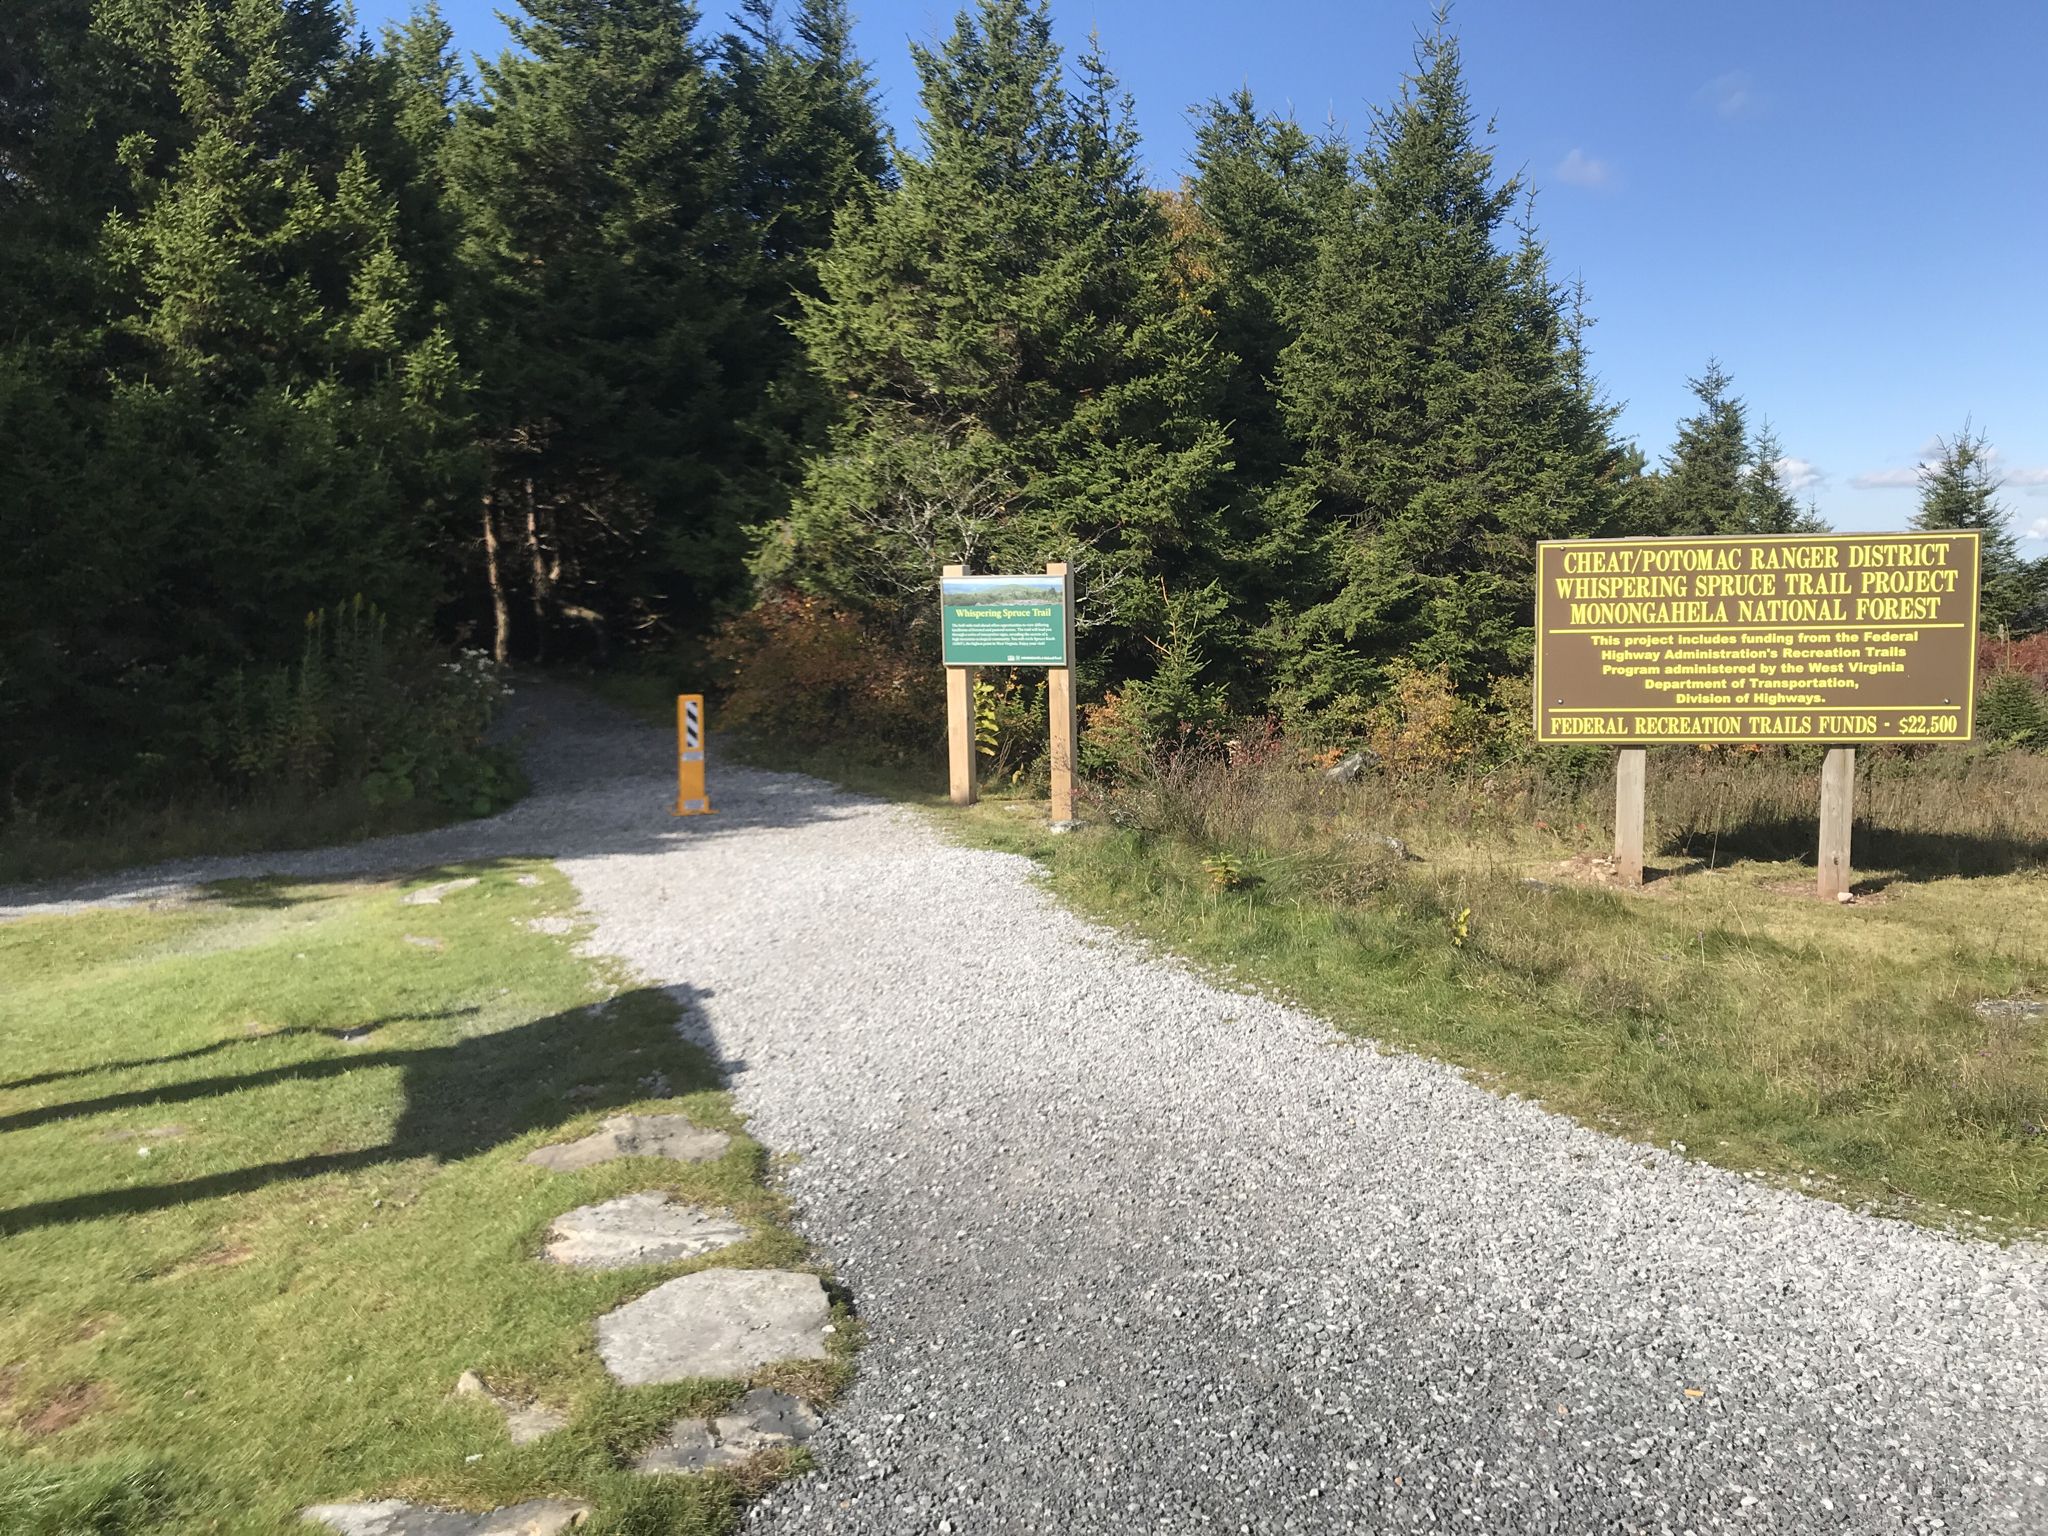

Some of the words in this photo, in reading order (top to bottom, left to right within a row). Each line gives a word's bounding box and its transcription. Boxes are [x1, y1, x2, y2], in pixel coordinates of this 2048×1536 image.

[1564, 548, 1742, 574] CHEAT/POTOMAC
[1751, 546, 1839, 570] RANGER
[1848, 544, 1950, 568] DISTRICT
[1556, 576, 1687, 599] WHISPERING
[1695, 574, 1776, 597] SPRUCE
[1785, 572, 1852, 596] TRAIL
[1861, 570, 1958, 594] PROJECT
[956, 609, 1002, 619] Whispering
[1002, 608, 1030, 619] Spruce
[1032, 608, 1051, 617] Trail
[1570, 601, 1728, 625] MONONGAHELA
[1738, 599, 1847, 622] NATIONAL
[1856, 597, 1941, 620] FOREST
[1591, 635, 1620, 646] This
[1624, 634, 1674, 647] project
[1678, 634, 1737, 645] includes
[1741, 634, 1794, 646] funding
[1798, 633, 1830, 643] from
[1836, 632, 1859, 642] the
[1864, 631, 1918, 642] Federal
[1602, 650, 1660, 662] Highway
[1664, 648, 1778, 660] Administration's
[1783, 647, 1860, 658] Recreation
[1865, 646, 1906, 657] Trails
[1602, 665, 1660, 676] Program
[1664, 664, 1755, 674] administered
[1760, 663, 1776, 676] by
[1781, 663, 1804, 673] the
[1808, 662, 1844, 672] West
[1848, 662, 1904, 674] Virginia
[1644, 678, 1728, 690] Department
[1731, 678, 1746, 688] of
[1749, 678, 1859, 690] Transportation,
[1676, 693, 1731, 704] Division
[1735, 692, 1750, 703] of
[1754, 692, 1826, 705] Highways.
[1551, 717, 1628, 735] FEDERAL
[1635, 716, 1742, 734] RECREATION
[1749, 716, 1812, 734] TRAILS
[1818, 716, 1877, 734] FUNDS
[1899, 715, 1958, 735] $22,500
